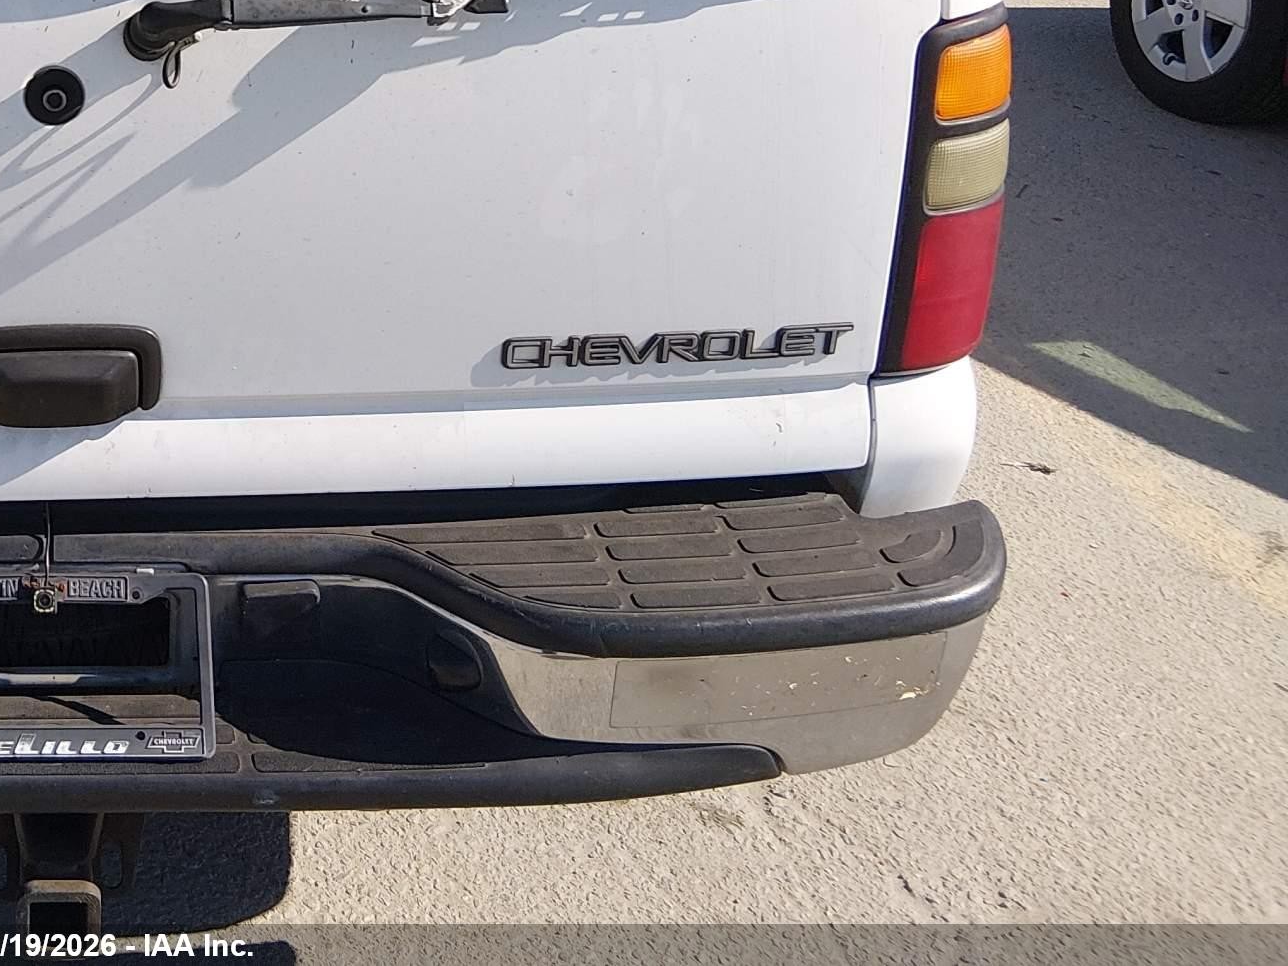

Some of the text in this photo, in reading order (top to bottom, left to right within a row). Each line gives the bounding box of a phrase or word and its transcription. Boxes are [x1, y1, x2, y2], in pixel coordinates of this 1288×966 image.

[501, 322, 854, 369] CHEVROLET
[66, 577, 126, 599] BEACH
[153, 737, 194, 746] CHEVROLET
